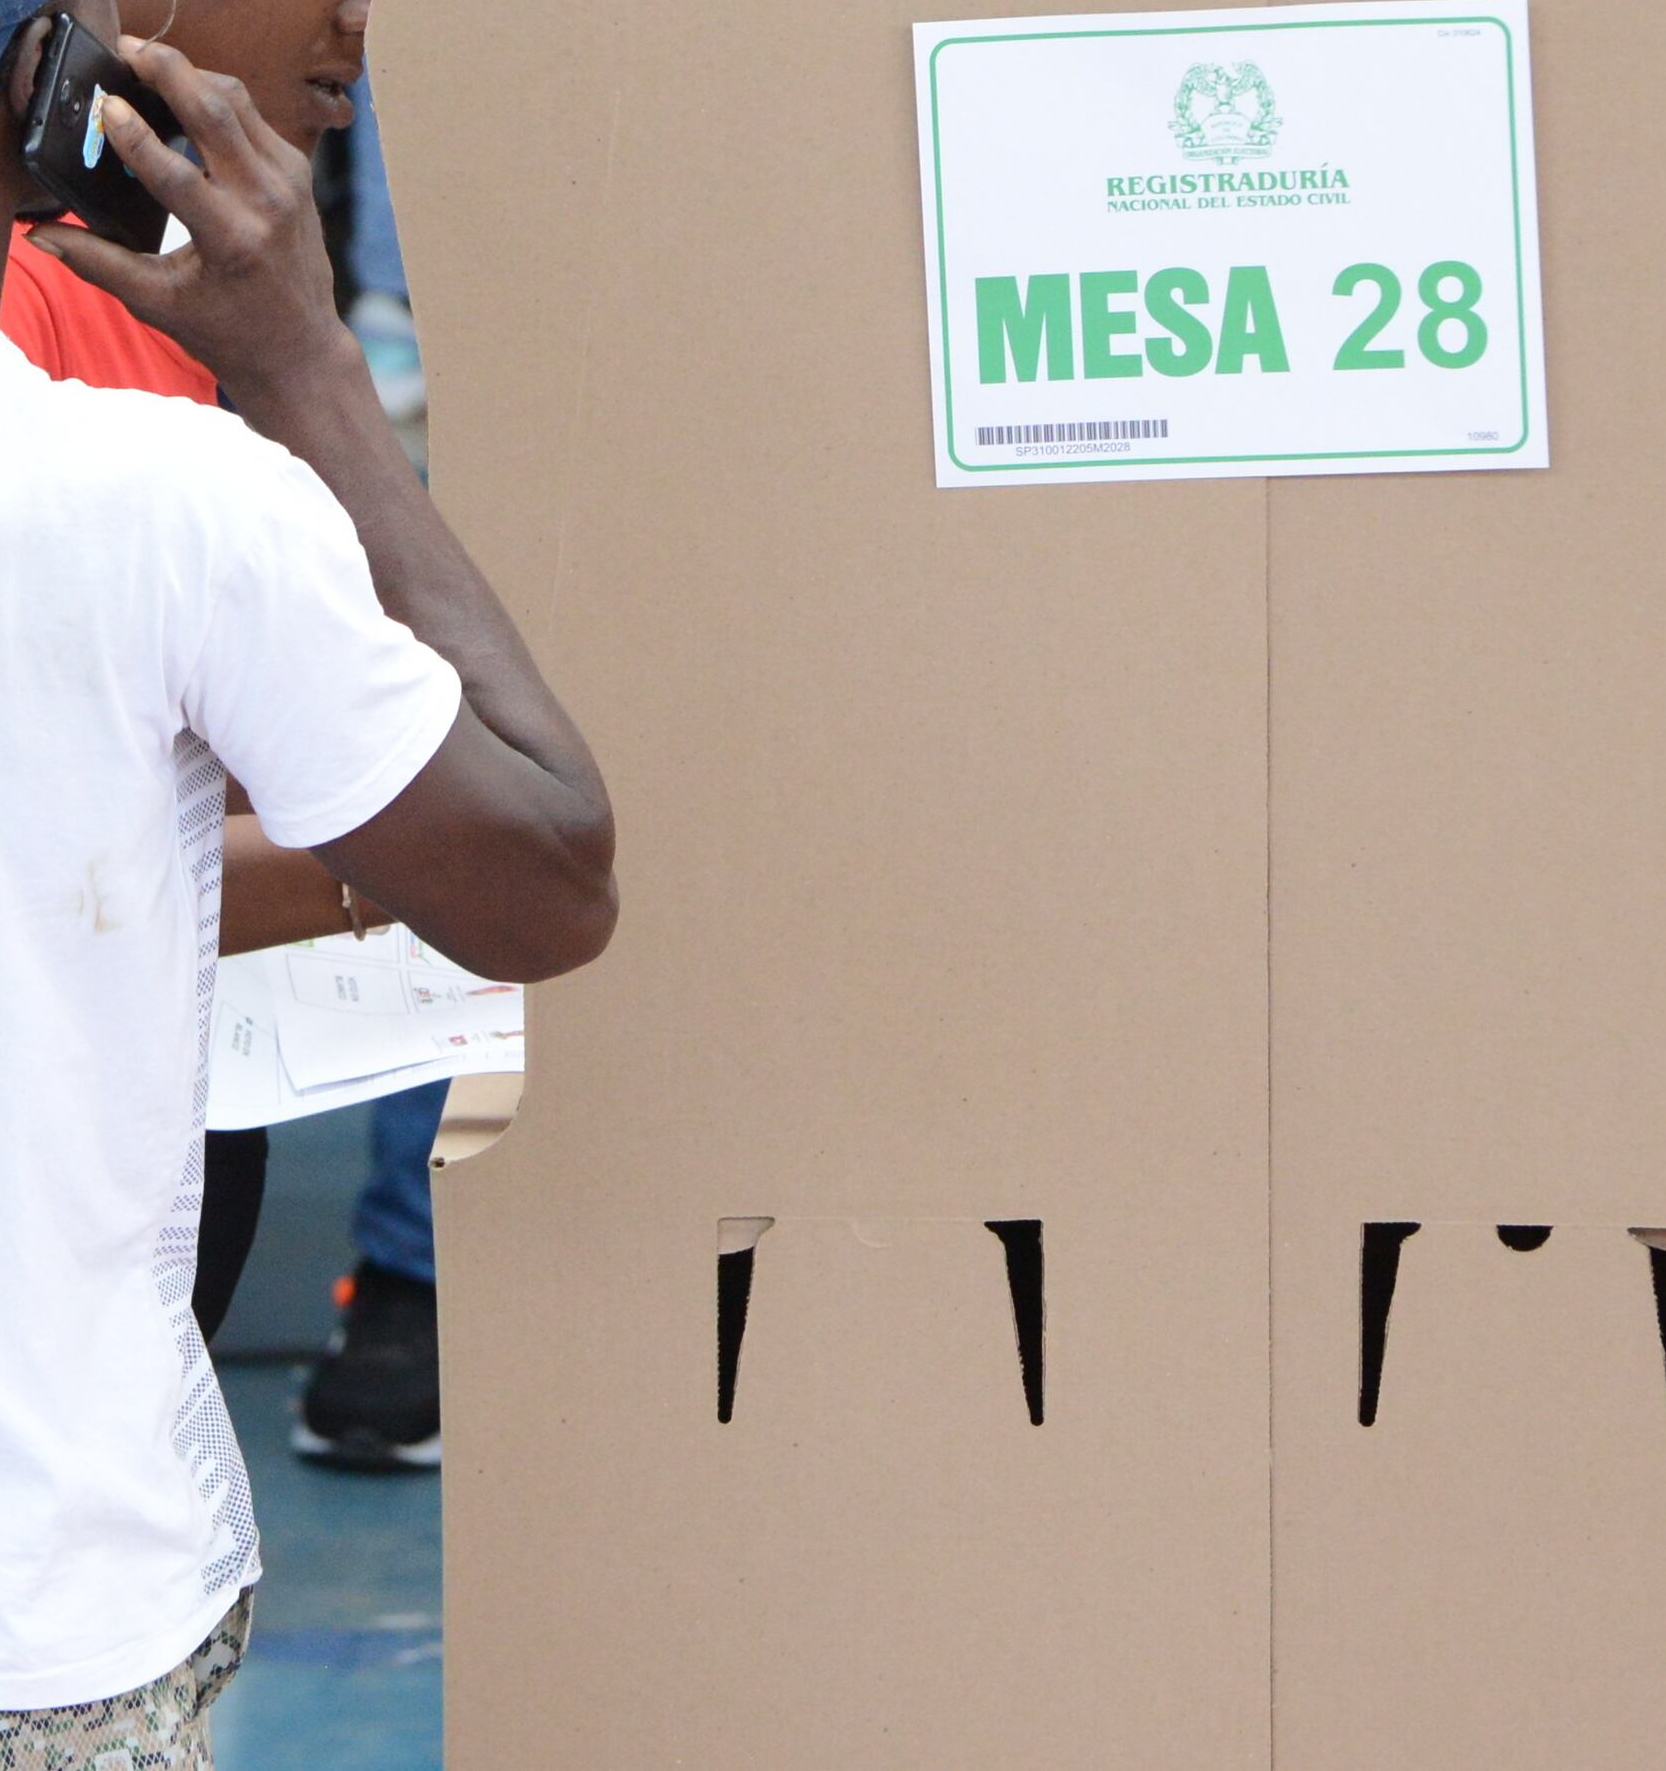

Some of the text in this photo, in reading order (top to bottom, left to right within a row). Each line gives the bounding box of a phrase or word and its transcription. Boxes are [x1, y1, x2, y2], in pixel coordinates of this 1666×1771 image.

[1106, 162, 1350, 197] REGISTRADURÍA
[1107, 192, 1351, 213] NACIONAL DEL ESTADO CIVIL
[974, 260, 1489, 385] MESA 28
